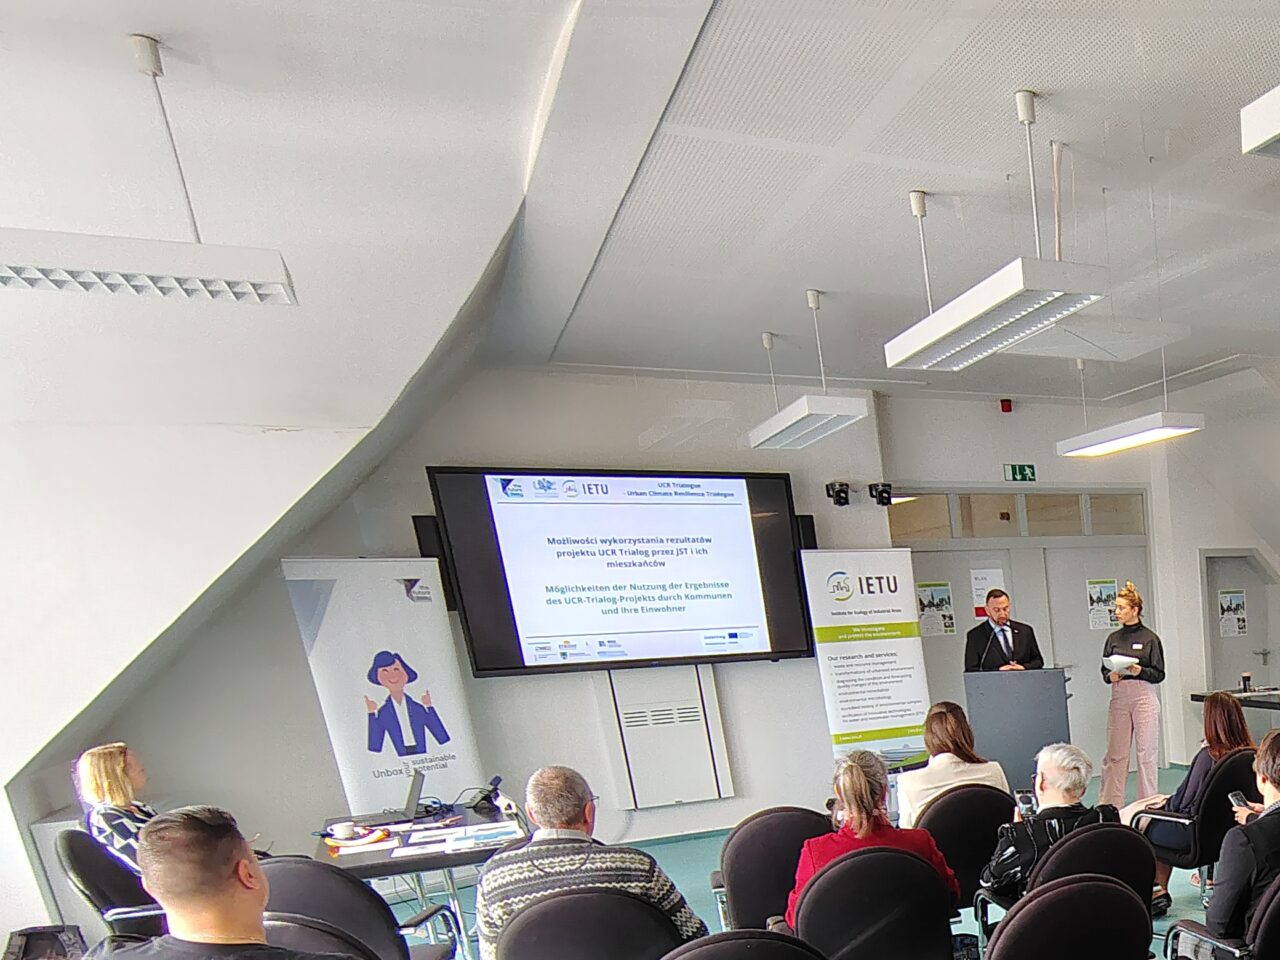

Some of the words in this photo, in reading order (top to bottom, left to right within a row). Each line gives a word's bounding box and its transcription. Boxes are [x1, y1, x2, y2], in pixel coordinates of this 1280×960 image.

[582, 483, 609, 495] IETU
[546, 536, 598, 545] Możliwości
[599, 536, 665, 546] wykorzystania
[665, 536, 713, 544] rezultatów
[556, 548, 597, 559] projektu
[598, 548, 618, 557] UCR
[618, 547, 650, 558] Trialog
[651, 548, 675, 557] przez
[676, 547, 688, 557] JST
[695, 547, 709, 555] ich
[606, 559, 666, 569] mieszkańców
[544, 584, 611, 595] Möglichkeiten
[612, 583, 627, 592] der
[629, 582, 668, 592] Nutzung
[668, 581, 683, 590] der
[684, 580, 730, 591] Ergebnisse
[858, 575, 898, 595] IETU
[545, 597, 562, 605] des
[564, 594, 656, 605] UCR-Trialog-Projekts
[657, 593, 683, 602] durch
[684, 592, 733, 601] Kommunen
[601, 606, 619, 615] und
[640, 605, 686, 614] Einwohner
[411, 753, 456, 766] sustainable
[372, 768, 404, 779] Unbox
